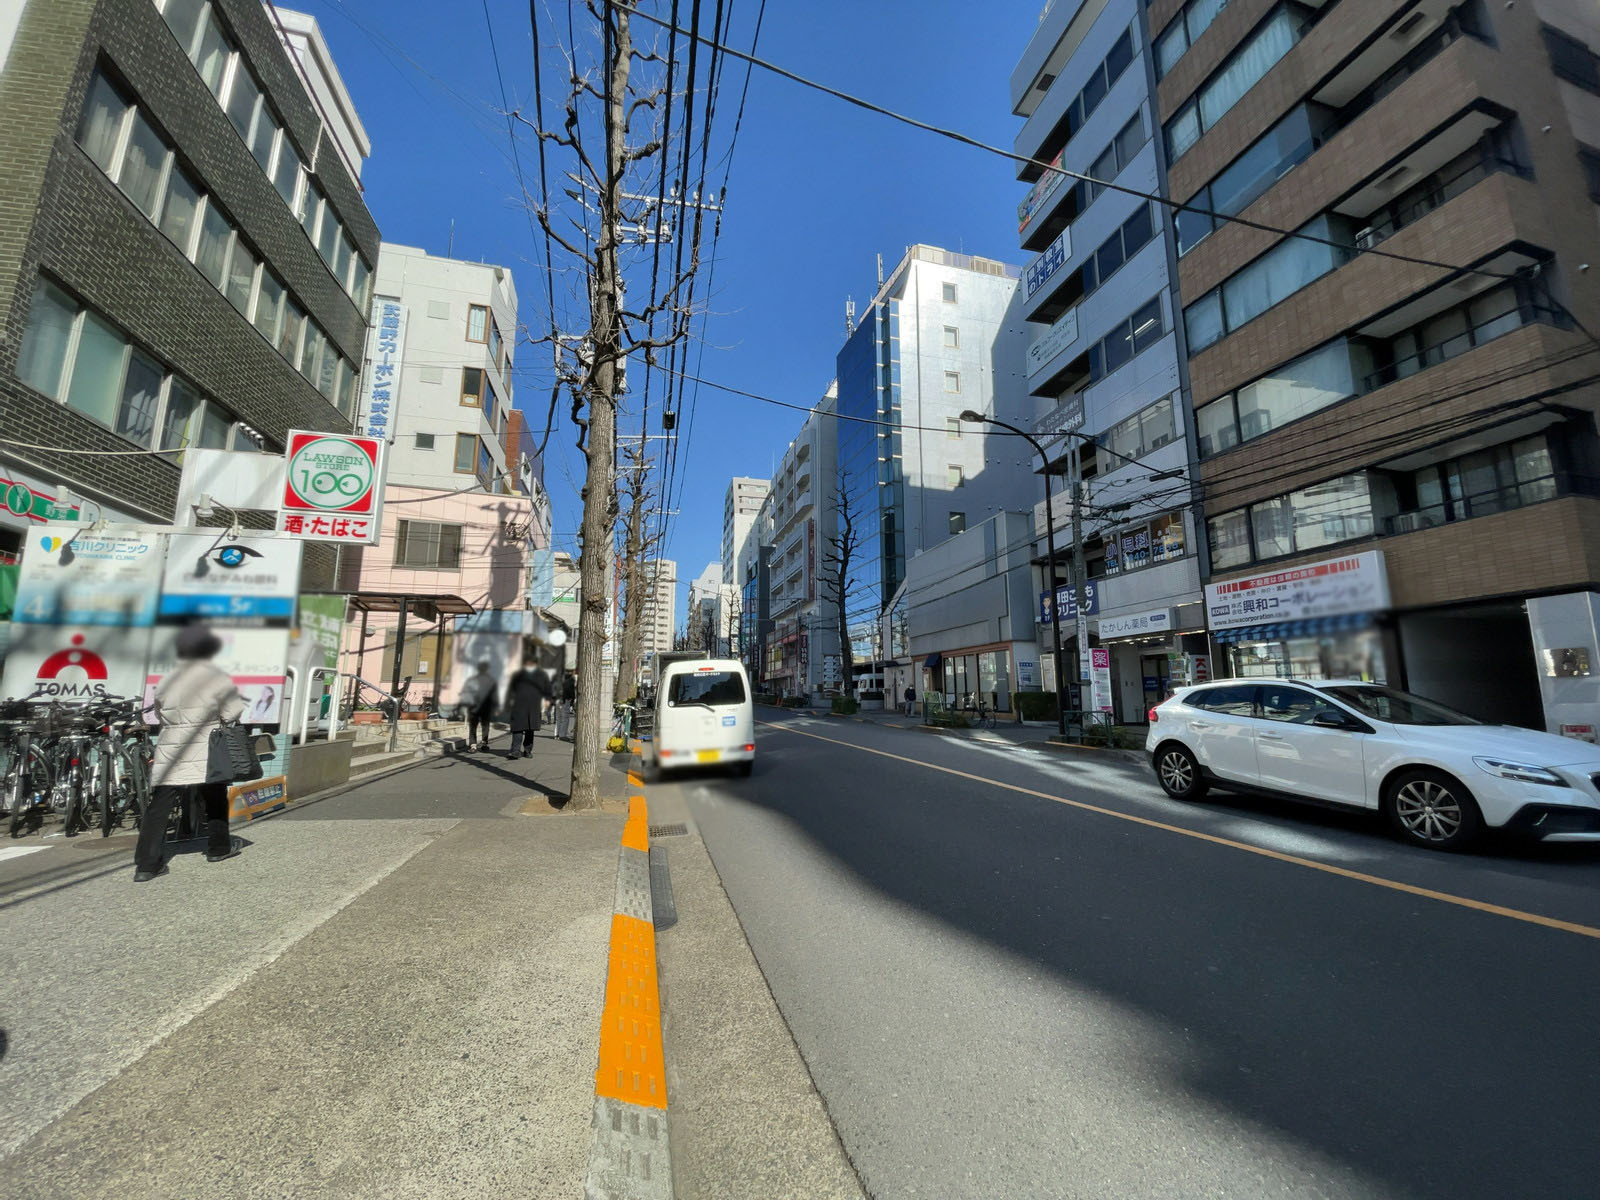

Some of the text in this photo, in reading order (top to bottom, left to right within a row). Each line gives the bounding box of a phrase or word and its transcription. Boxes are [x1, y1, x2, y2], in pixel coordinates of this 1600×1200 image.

[303, 452, 364, 466] LAWSON
[315, 462, 350, 471] STORE
[300, 469, 364, 497] 100
[284, 515, 368, 538] 酒・たばこ
[1106, 531, 1150, 559] 小児科
[1212, 607, 1229, 616] KOWA
[1101, 616, 1149, 634] たかしん薬局
[1093, 651, 1107, 666] 薬
[34, 682, 106, 697] TOMAS
